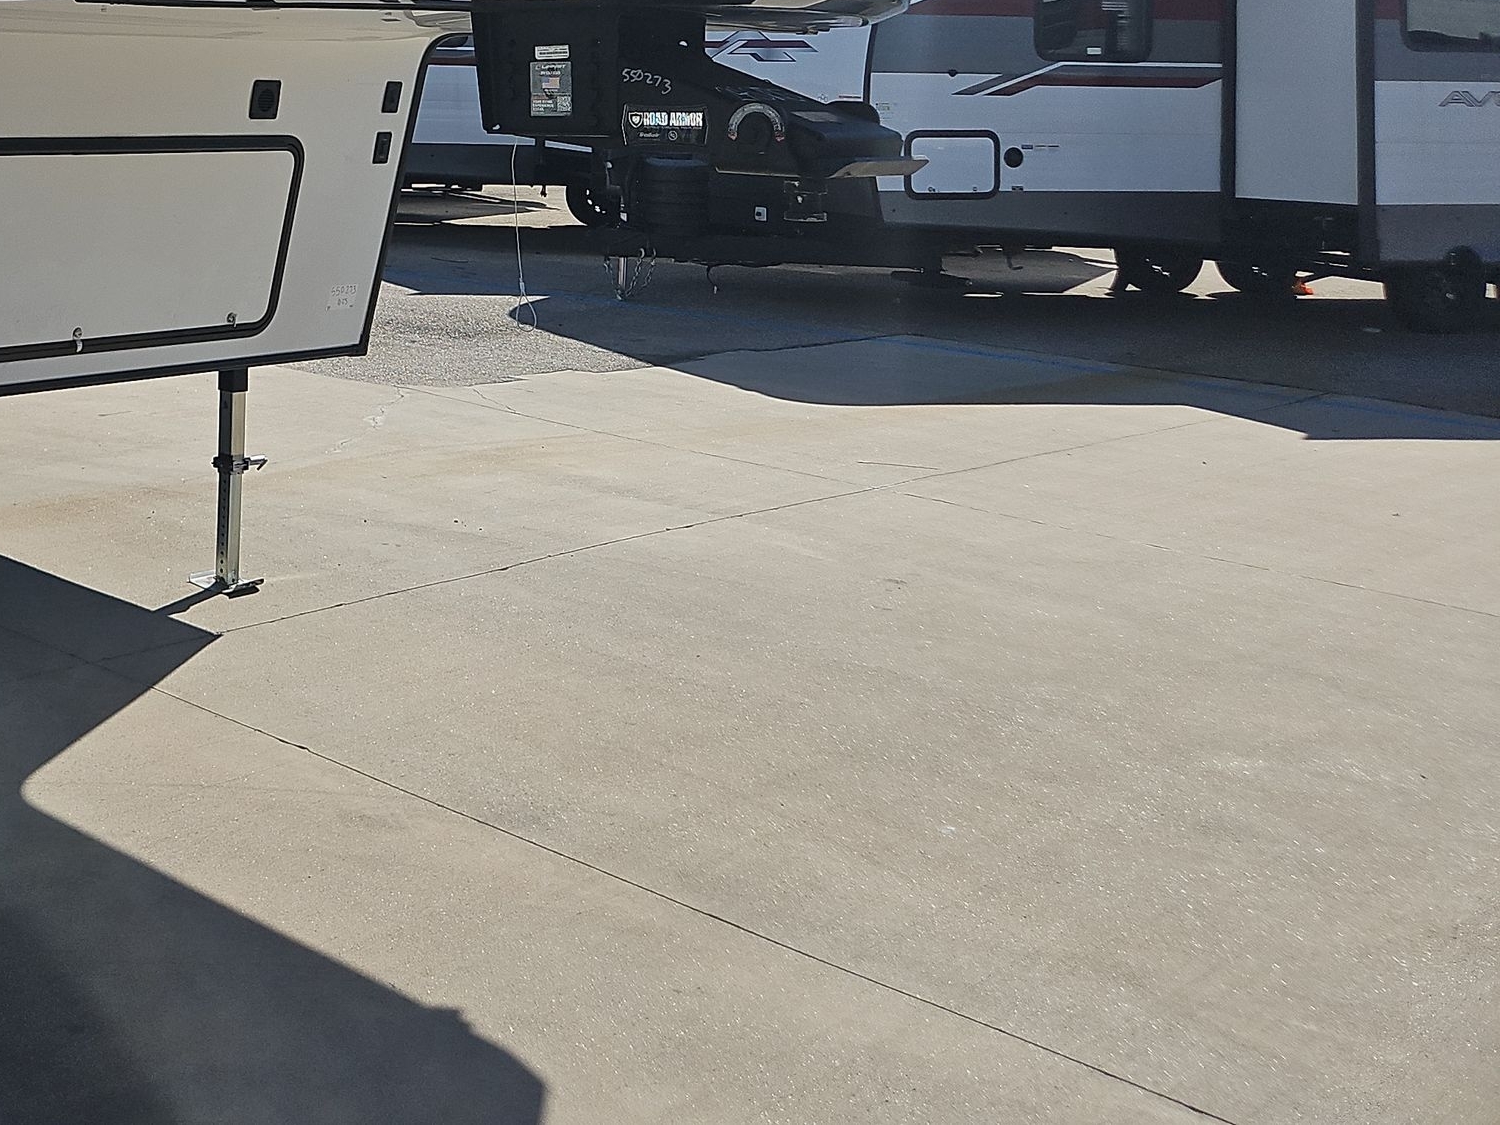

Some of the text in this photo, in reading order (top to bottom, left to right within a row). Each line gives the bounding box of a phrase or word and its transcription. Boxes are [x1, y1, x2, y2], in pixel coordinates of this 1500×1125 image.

[621, 68, 672, 95] 550273
[643, 111, 704, 127] ROAD ARMOR
